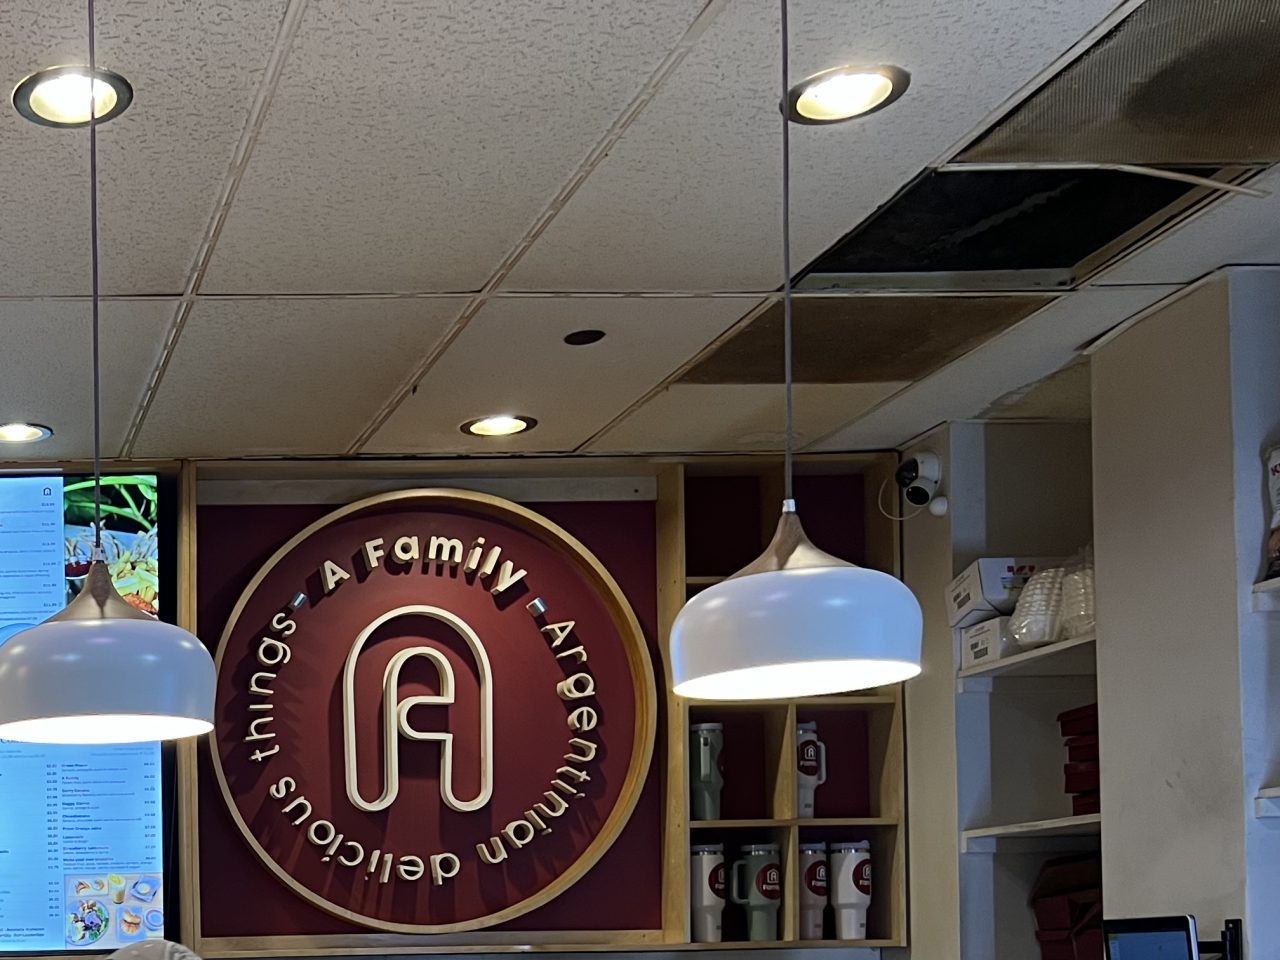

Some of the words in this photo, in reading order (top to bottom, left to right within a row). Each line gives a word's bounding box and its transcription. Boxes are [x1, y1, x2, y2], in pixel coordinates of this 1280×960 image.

[322, 559, 351, 594] A
[364, 535, 528, 596] Family
[242, 611, 297, 764] things
[475, 619, 599, 865] Argentinian
[269, 775, 461, 886] delicious
